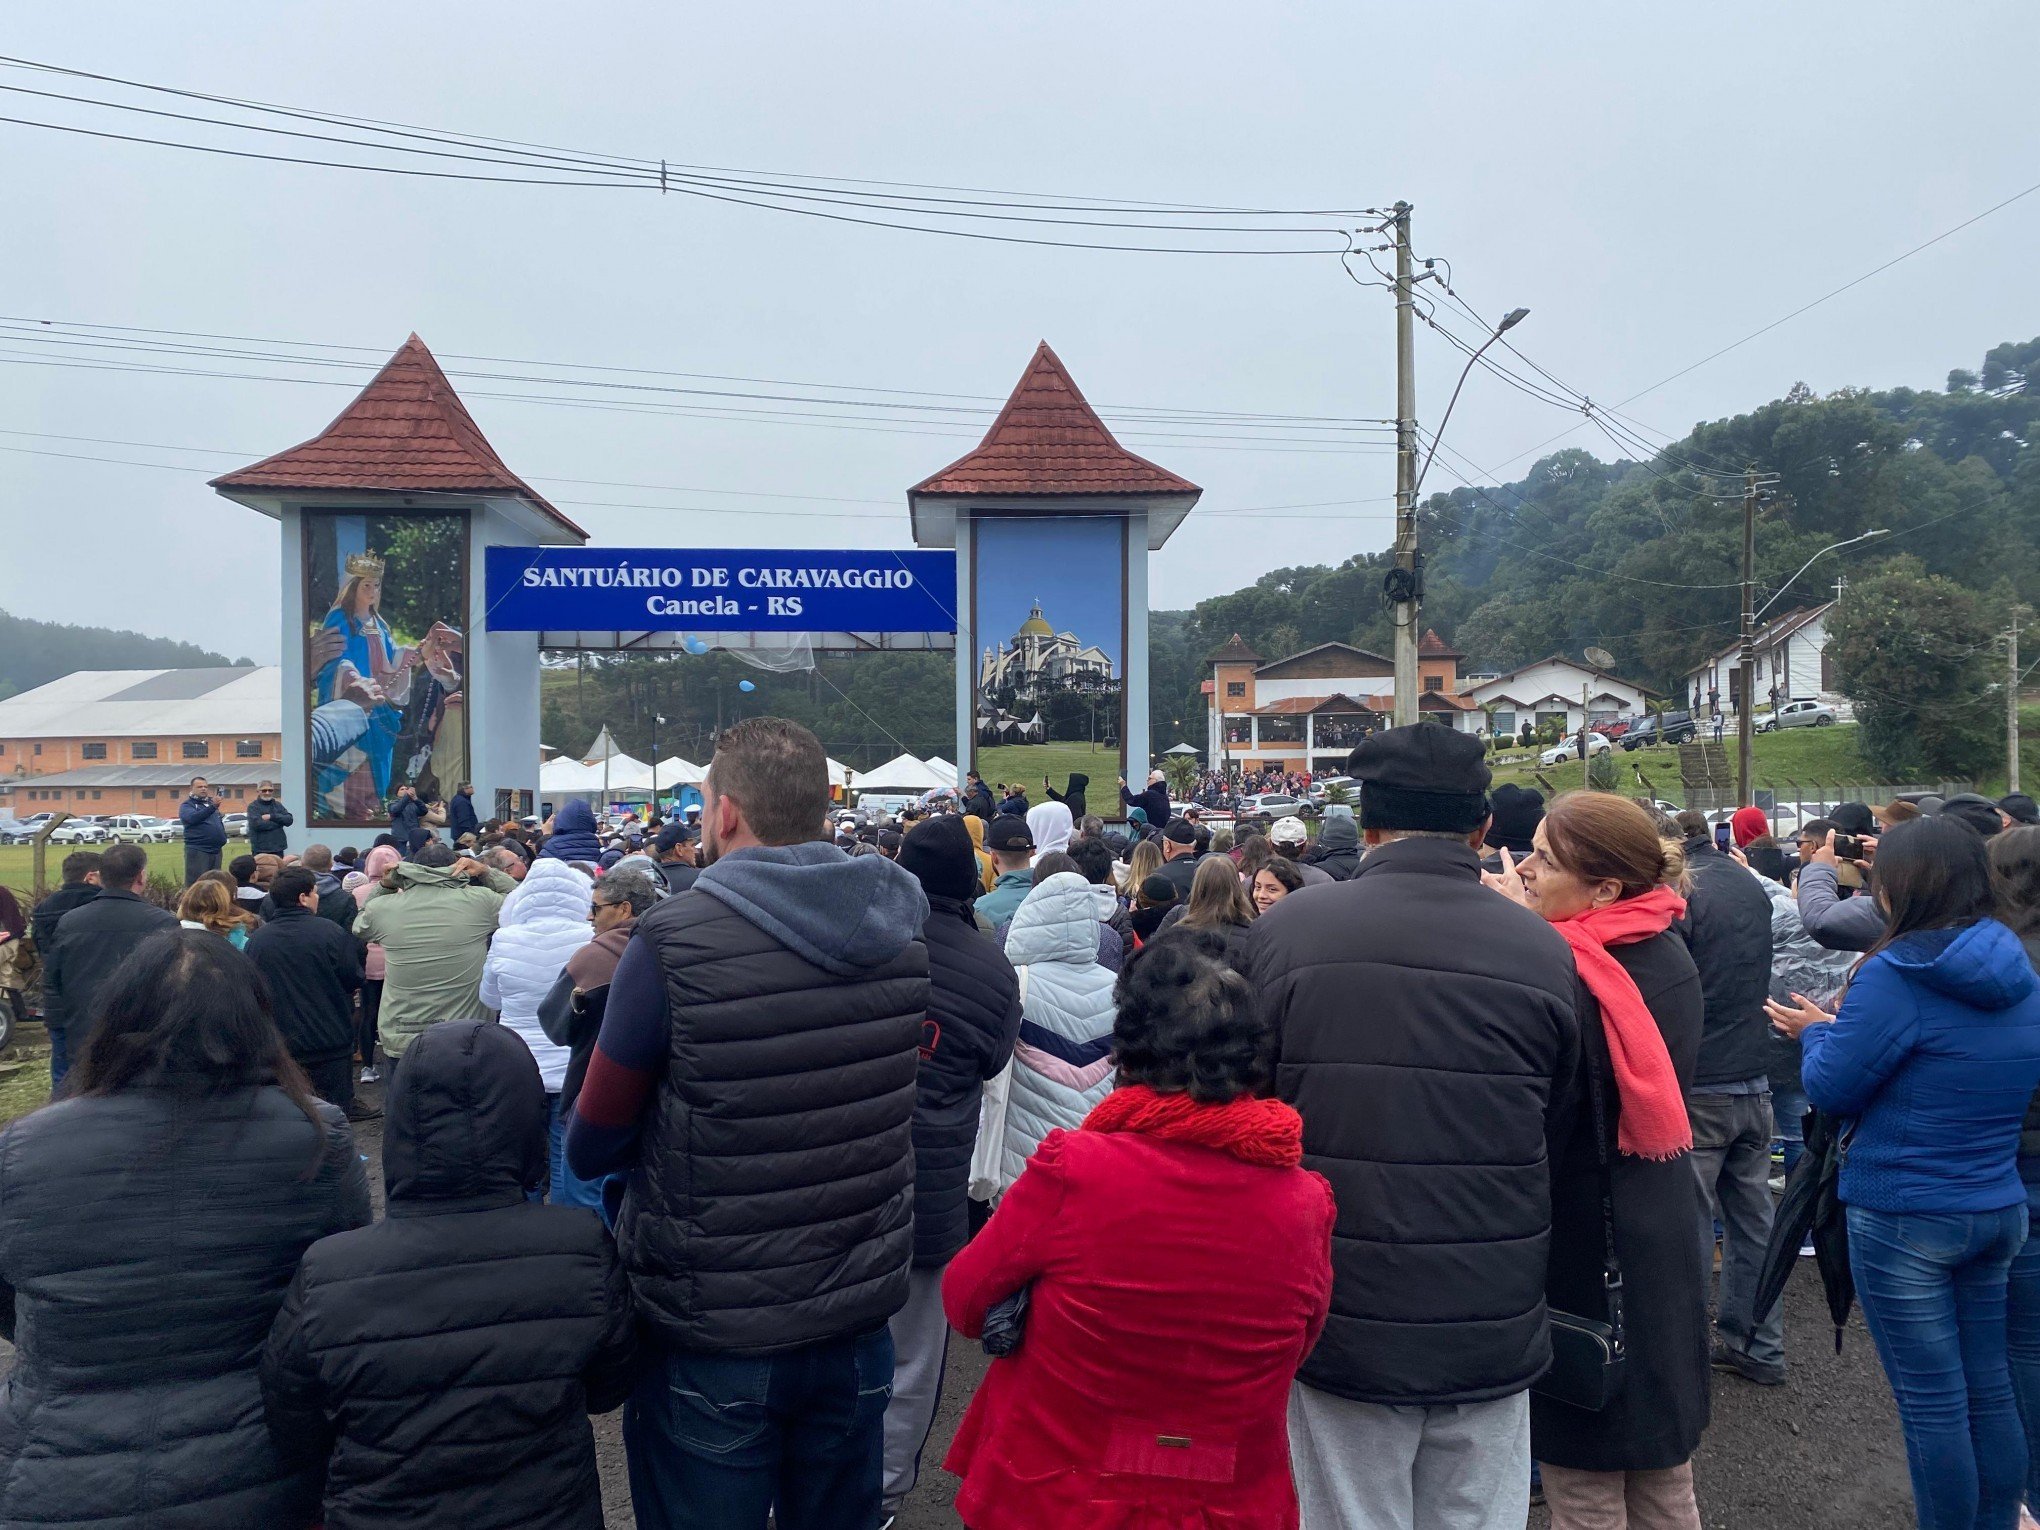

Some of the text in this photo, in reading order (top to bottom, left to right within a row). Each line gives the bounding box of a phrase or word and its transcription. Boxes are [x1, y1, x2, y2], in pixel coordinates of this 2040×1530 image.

[523, 561, 913, 588] SANTUÁRIO DE CARAVAGGIO
[646, 596, 739, 616] Canela
[766, 597, 803, 616] RS
